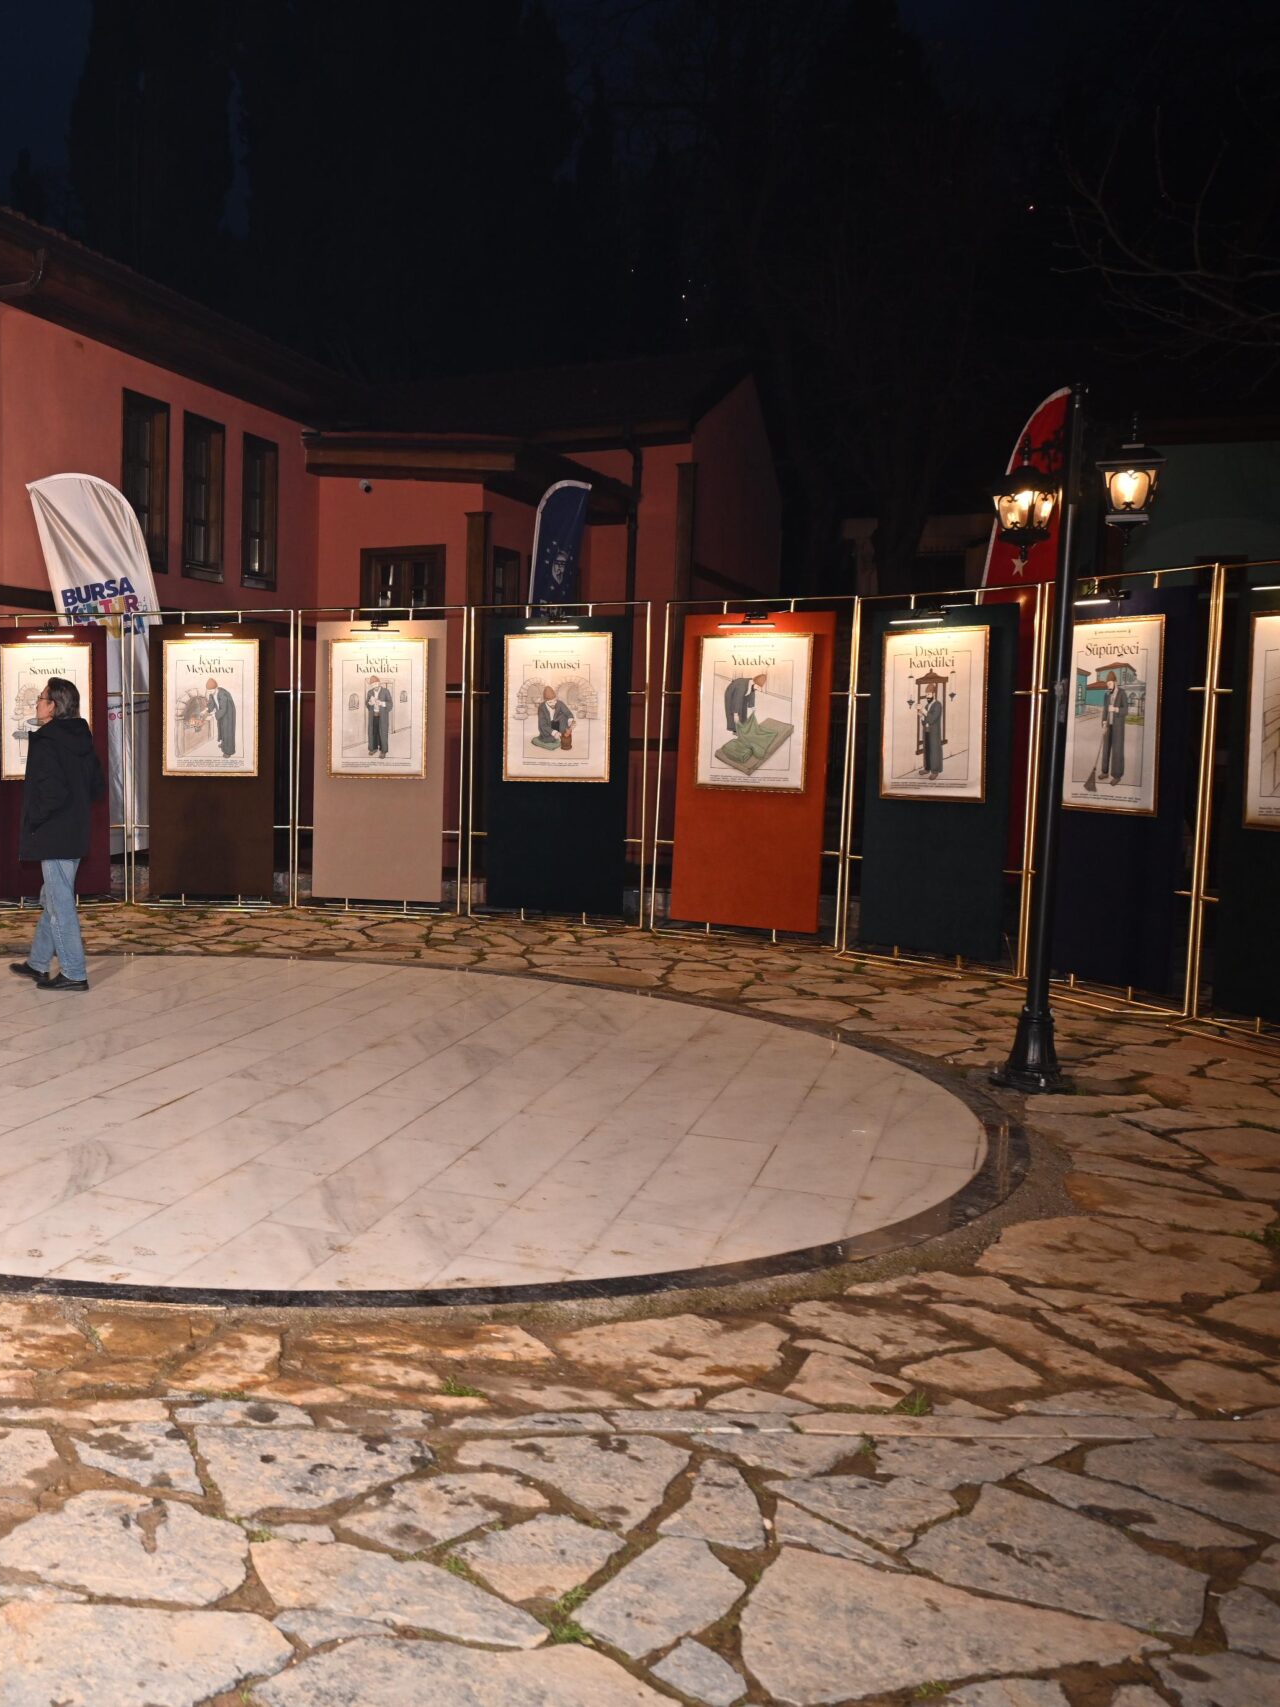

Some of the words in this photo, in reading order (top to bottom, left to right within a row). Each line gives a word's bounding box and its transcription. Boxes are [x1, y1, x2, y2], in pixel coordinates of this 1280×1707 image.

[61, 576, 135, 607] BURSA
[915, 645, 948, 658] Dışarı
[1085, 641, 1139, 659] Süpürgeci
[909, 656, 955, 669] Kandilci
